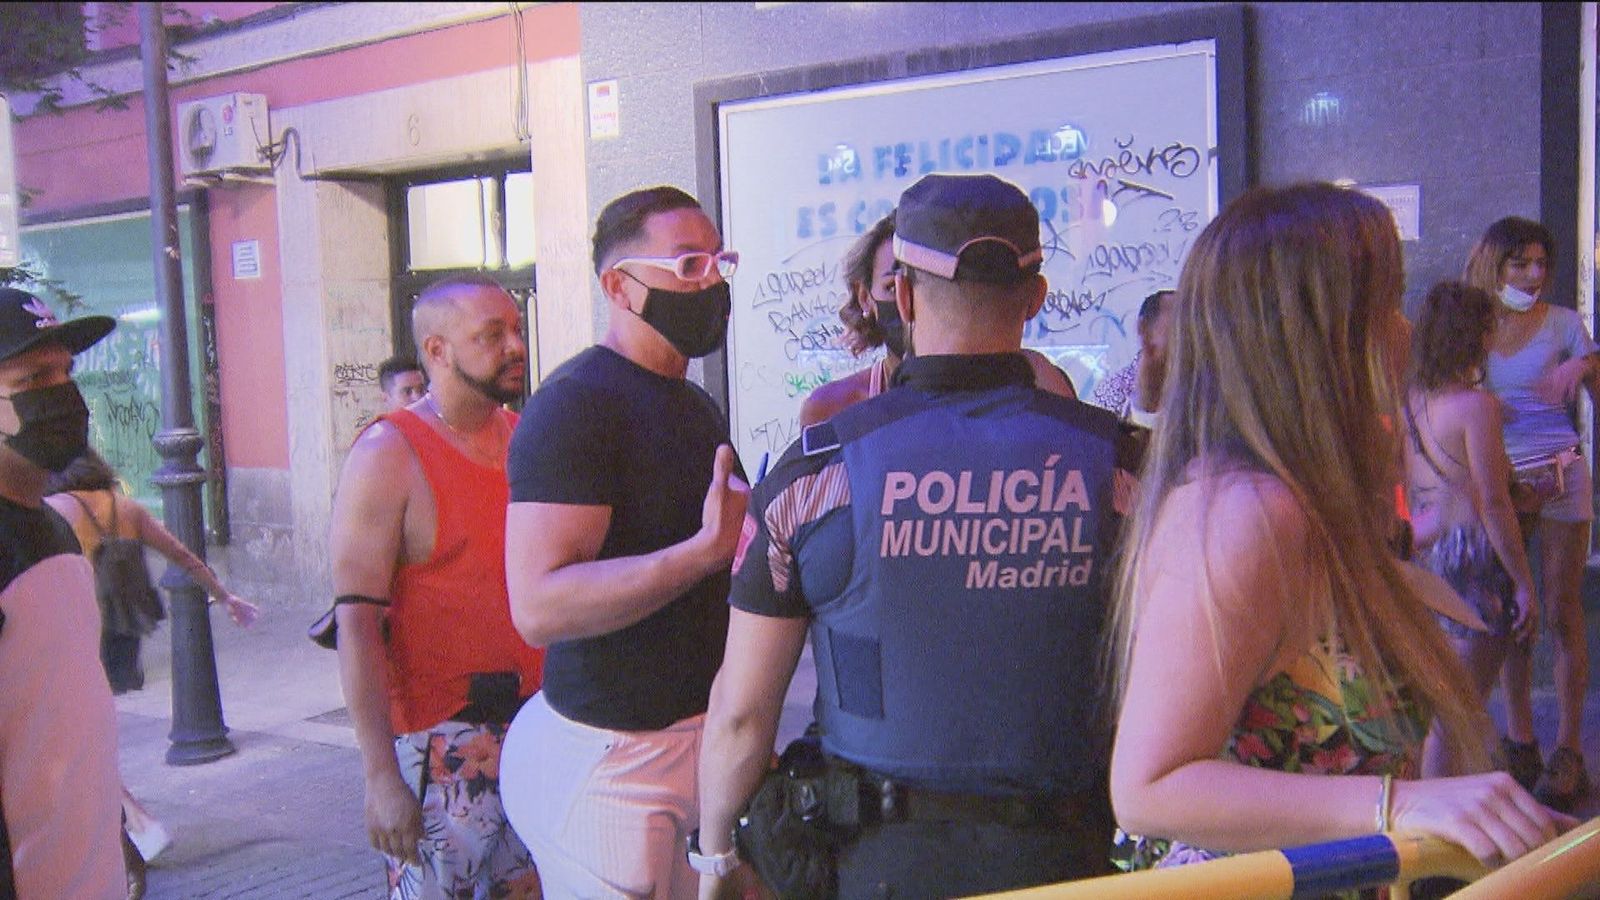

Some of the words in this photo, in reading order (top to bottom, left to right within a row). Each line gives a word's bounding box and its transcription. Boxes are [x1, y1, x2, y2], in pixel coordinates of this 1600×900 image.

[407, 112, 421, 146] 6
[873, 130, 1088, 178] FELICIDAD
[796, 202, 838, 238] ES
[880, 453, 1092, 516] POLICÍA
[879, 517, 1093, 558] MUNICIPAL
[965, 559, 1093, 589] Madrid
